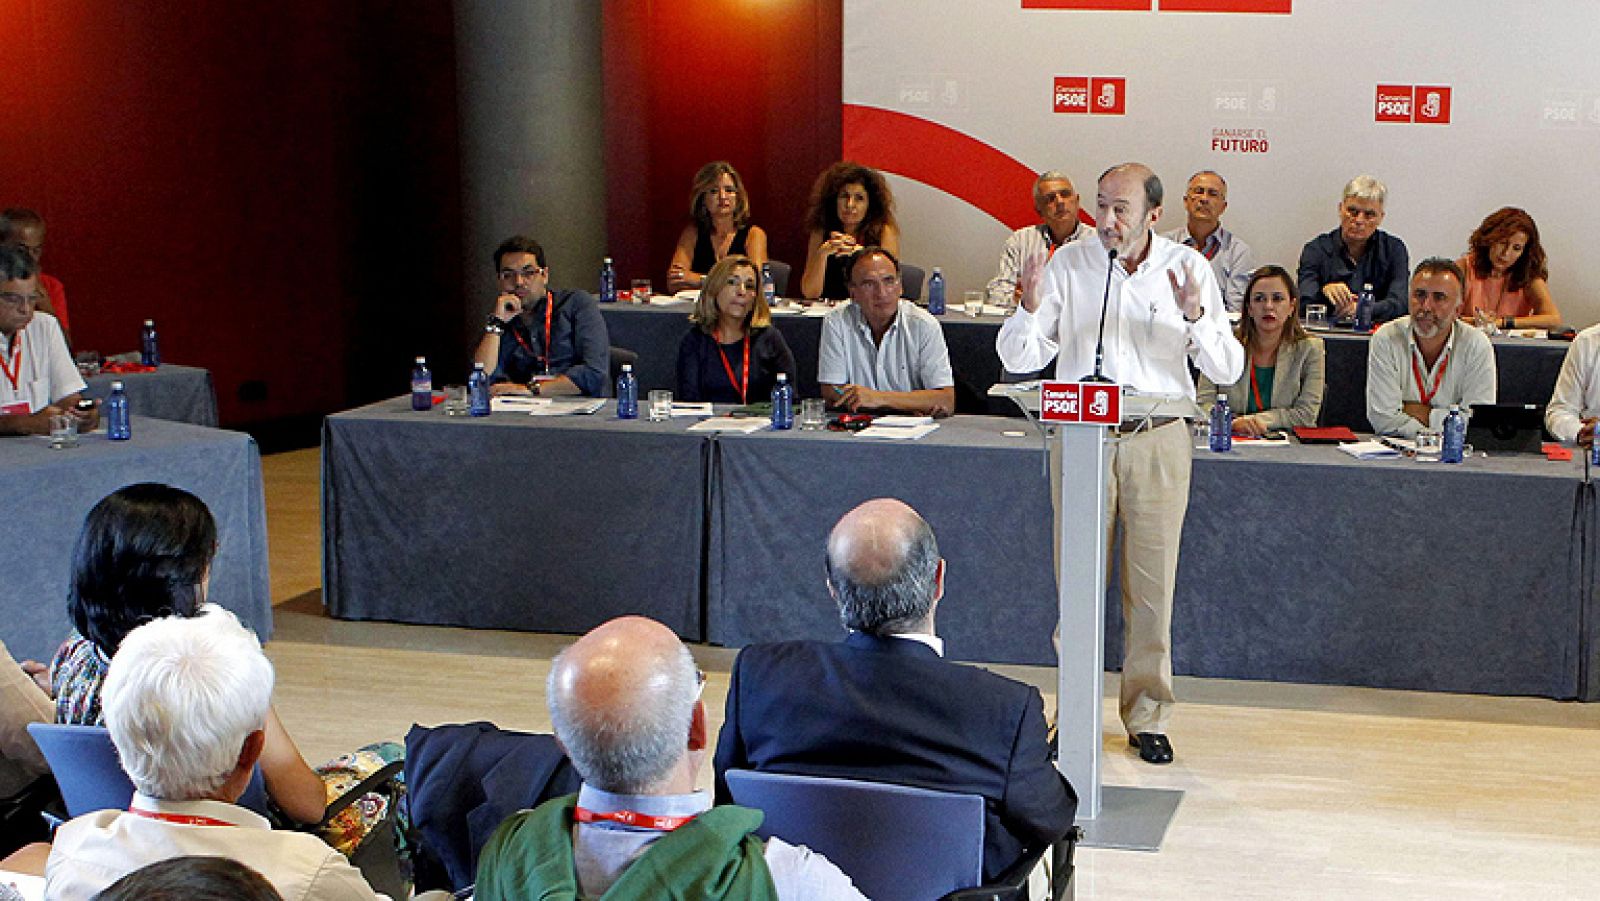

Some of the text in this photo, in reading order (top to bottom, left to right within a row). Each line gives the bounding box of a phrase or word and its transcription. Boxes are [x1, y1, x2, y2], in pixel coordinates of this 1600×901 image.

[1055, 93, 1087, 106] PSOE
[1215, 97, 1247, 111] PSOE
[1378, 101, 1411, 115] PSOE
[1211, 138, 1269, 153] FUTURO
[1044, 389, 1078, 399] Canarias
[1044, 399, 1078, 414] PSOE
